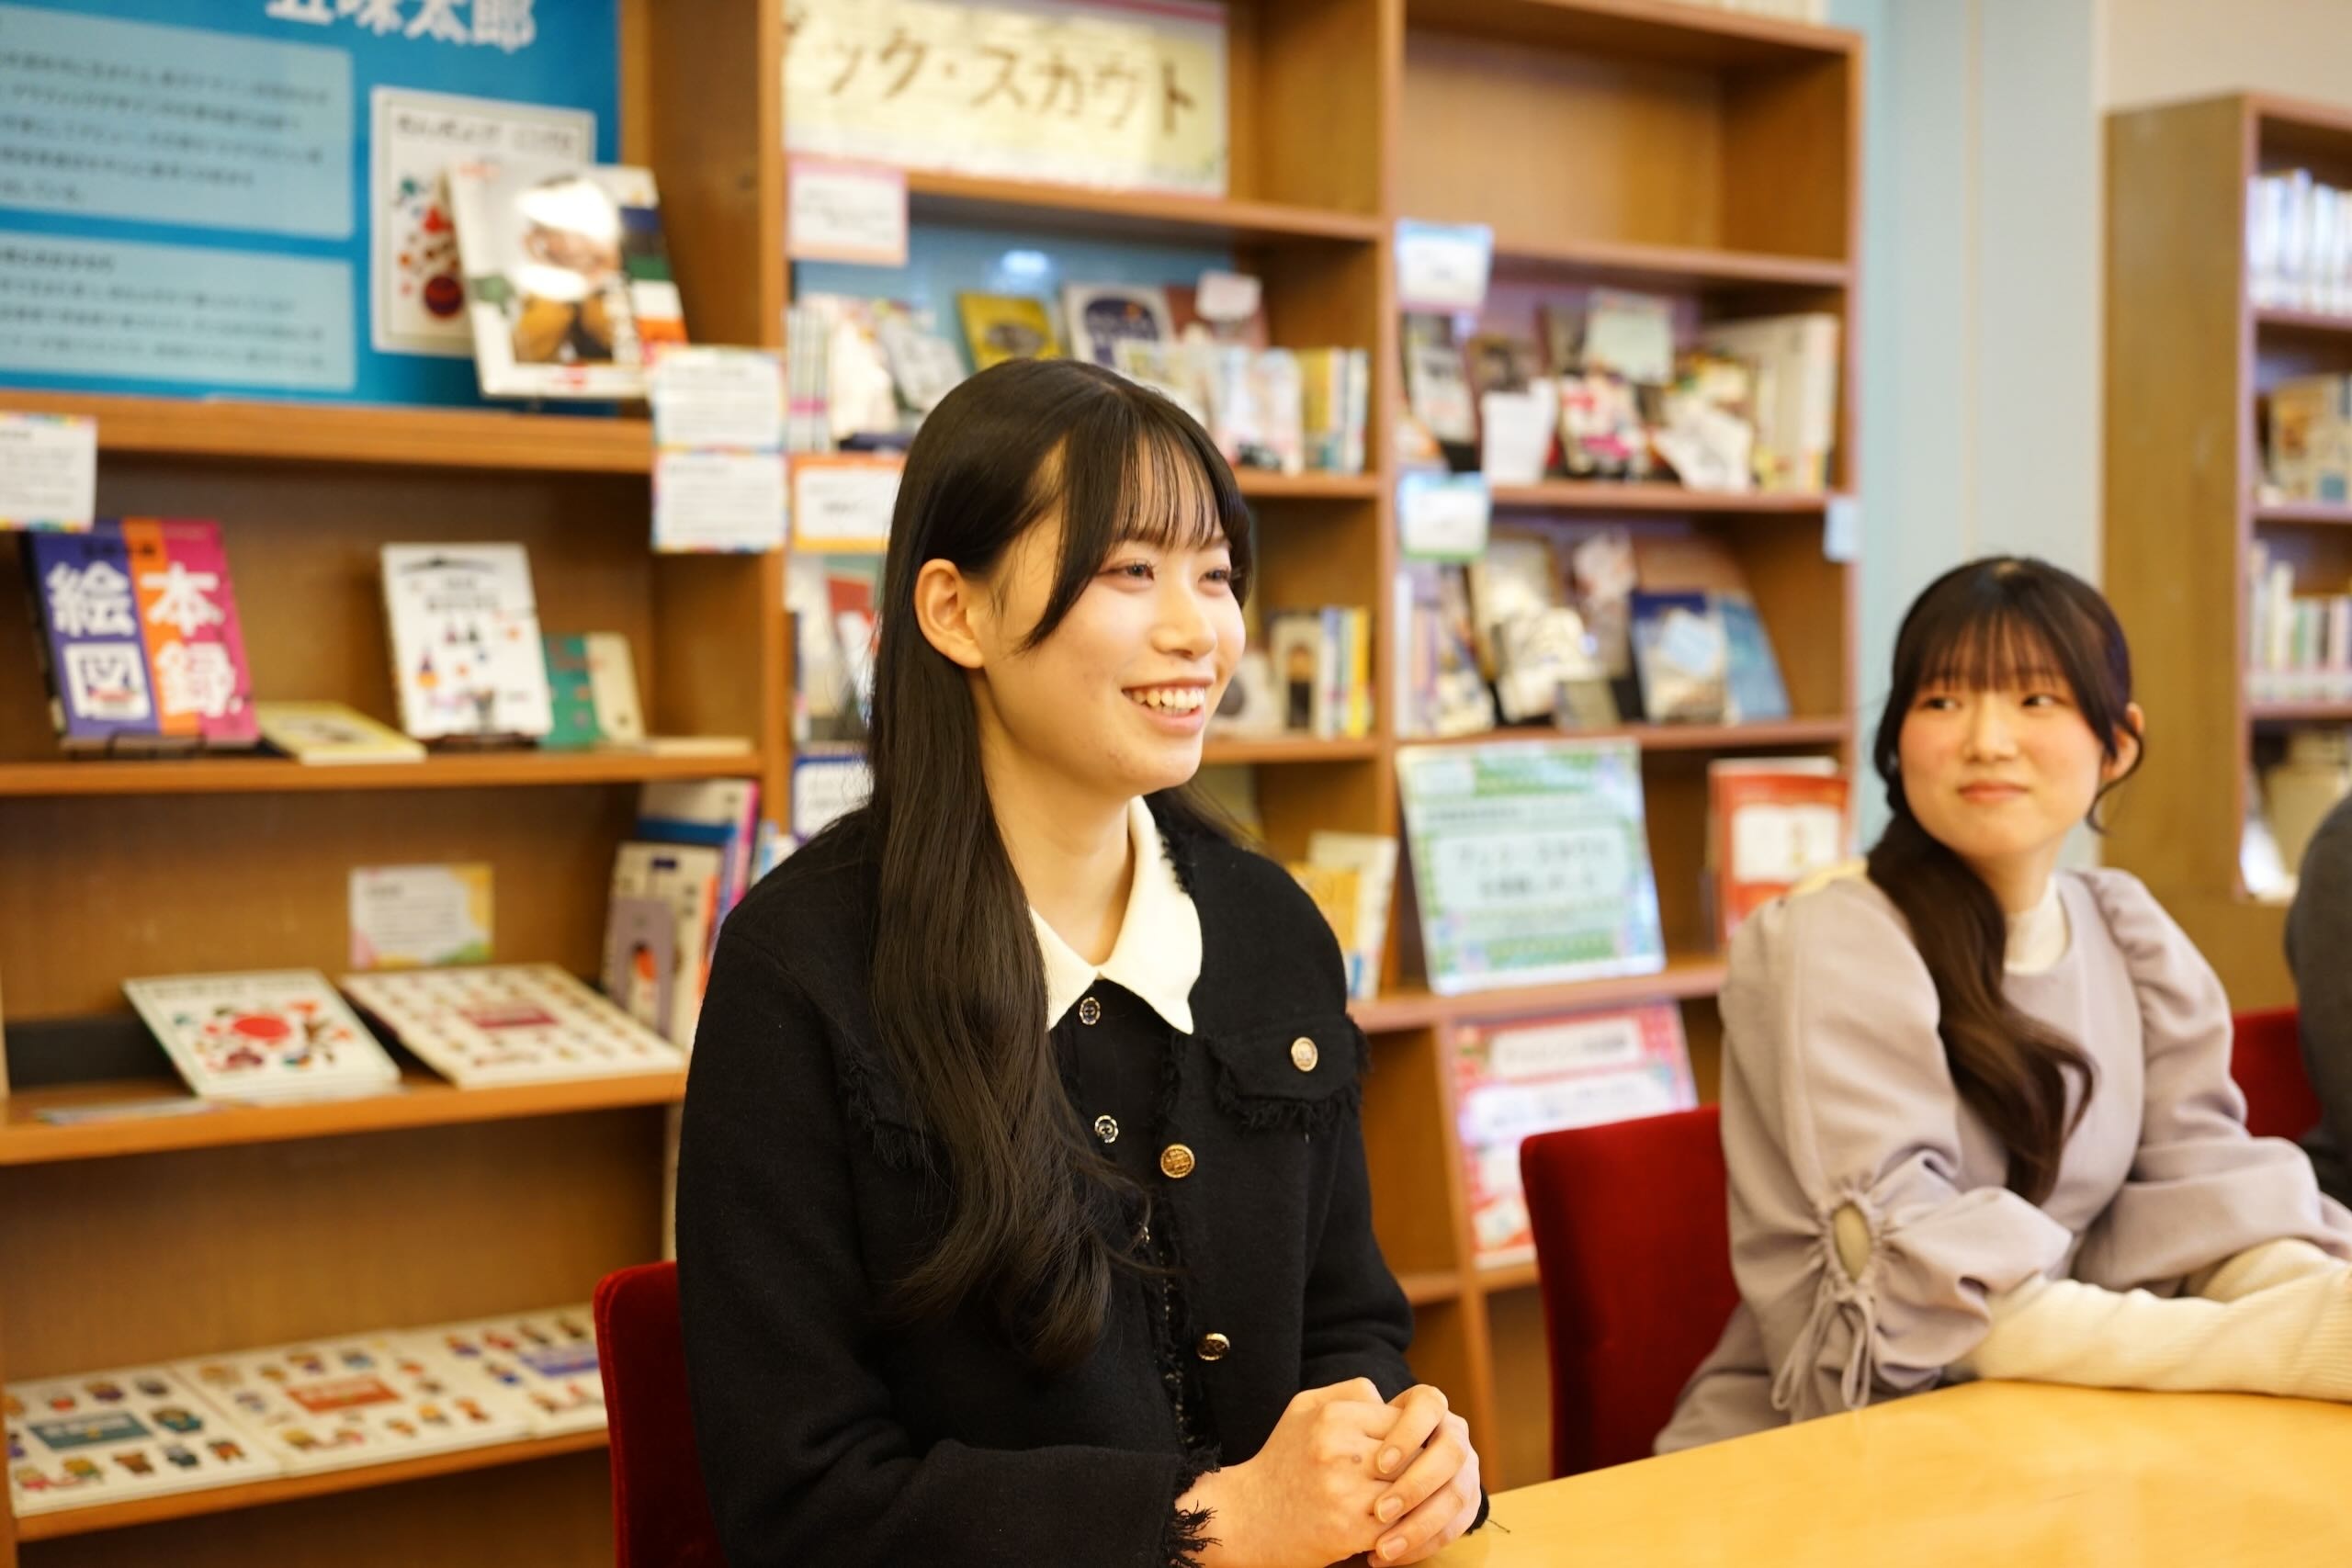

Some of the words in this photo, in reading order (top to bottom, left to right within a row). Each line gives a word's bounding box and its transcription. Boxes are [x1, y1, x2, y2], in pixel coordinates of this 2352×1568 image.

[783, 9, 1197, 137] ック・スカウト
[46, 559, 226, 638] 絵本
